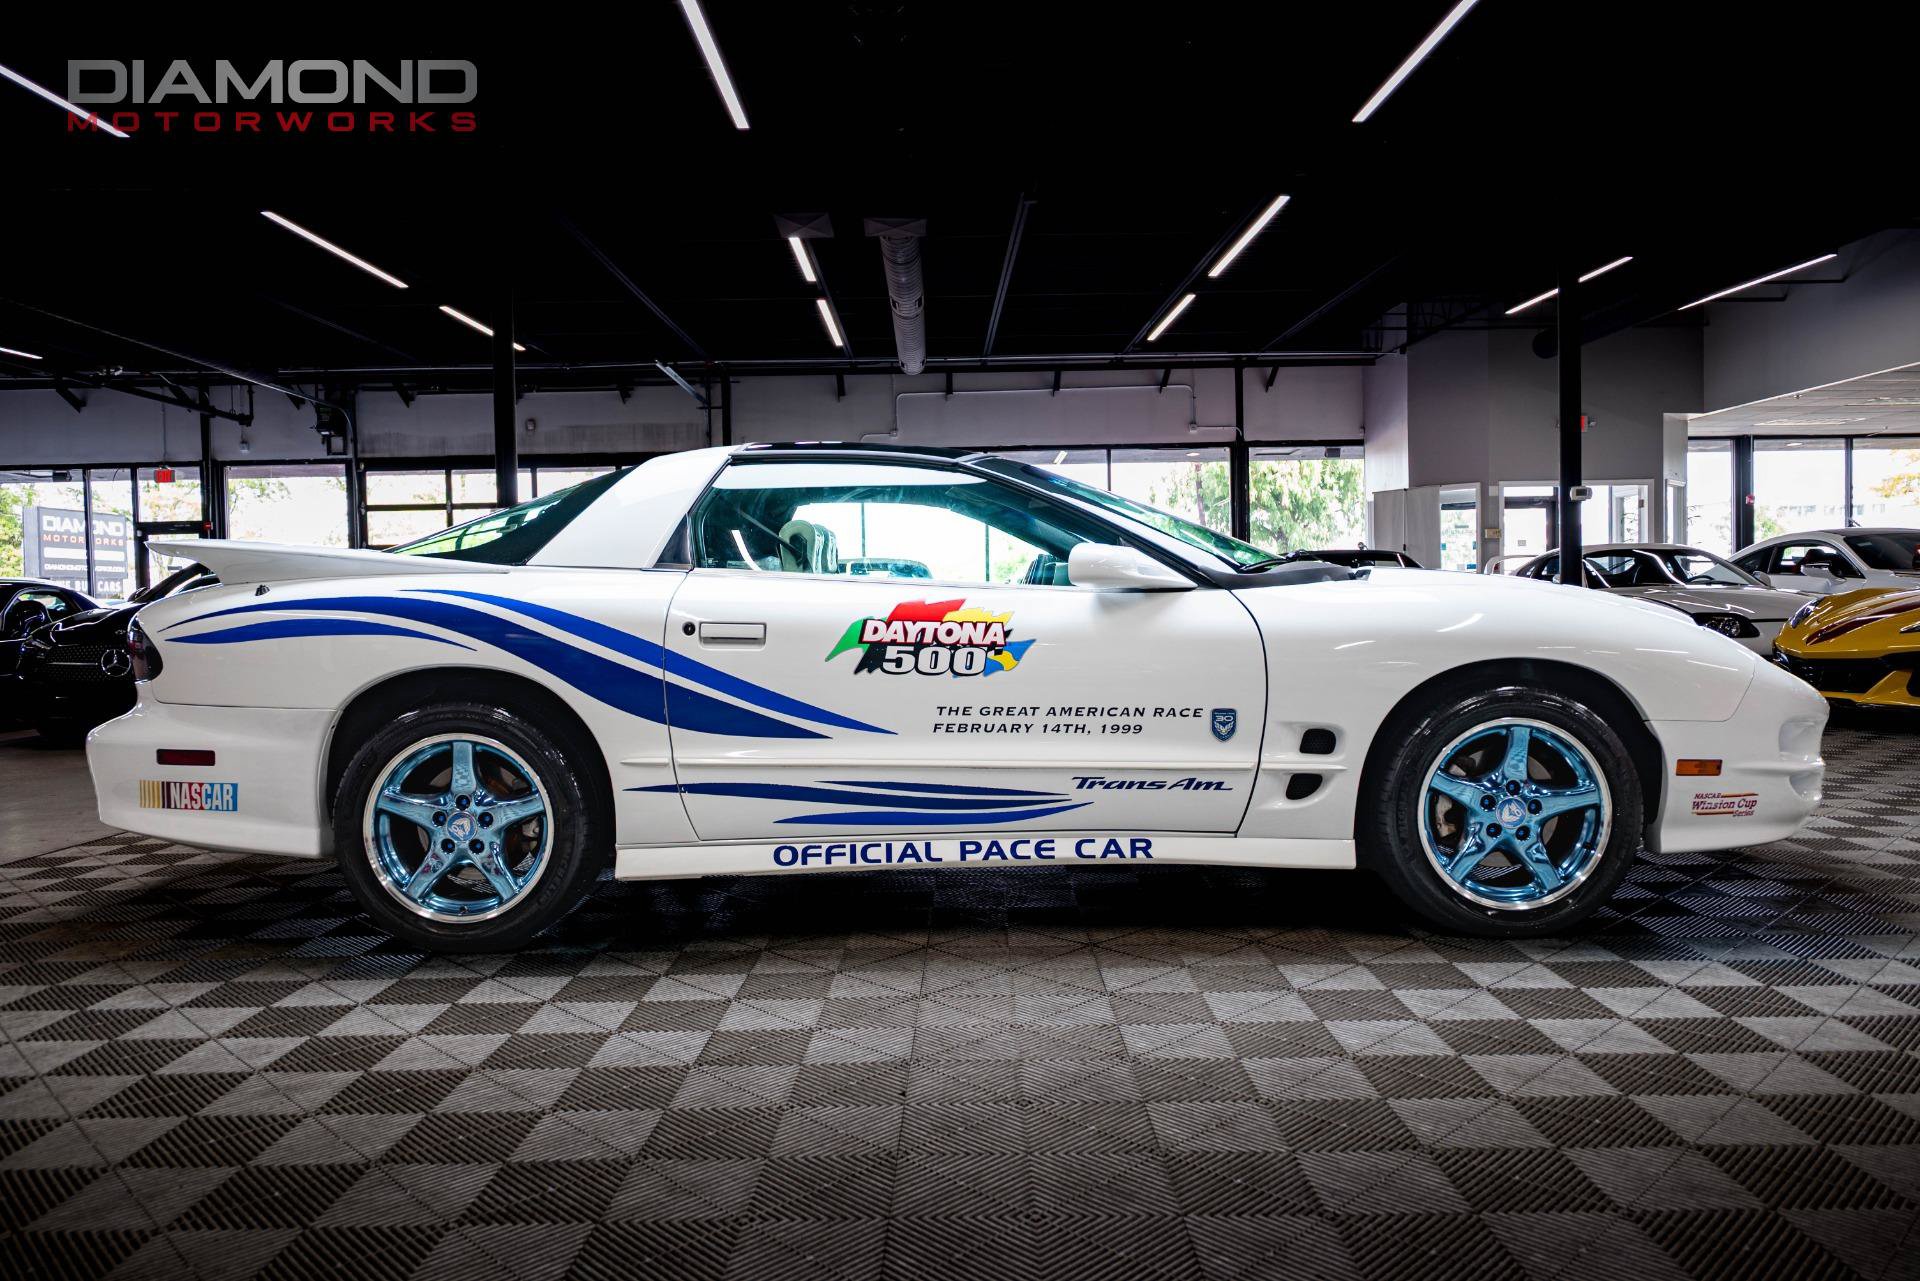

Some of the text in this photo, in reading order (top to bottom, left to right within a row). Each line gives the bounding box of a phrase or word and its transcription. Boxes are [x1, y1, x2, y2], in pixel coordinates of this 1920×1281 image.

[43, 534, 124, 546] MOTORORKS
[97, 581, 121, 592] CARS
[859, 619, 1006, 645] DAYTONA
[882, 645, 986, 676] 500
[936, 706, 1204, 718] THE GREAT AMERICAN RACE
[933, 723, 1143, 735] FEBRUARY 14TH, 1999
[1072, 776, 1234, 791] Trans Am
[169, 782, 233, 810] NASCAR
[1692, 798, 1758, 810] Winston Cup
[773, 837, 1154, 867] OFFICIAL PACE CAR
